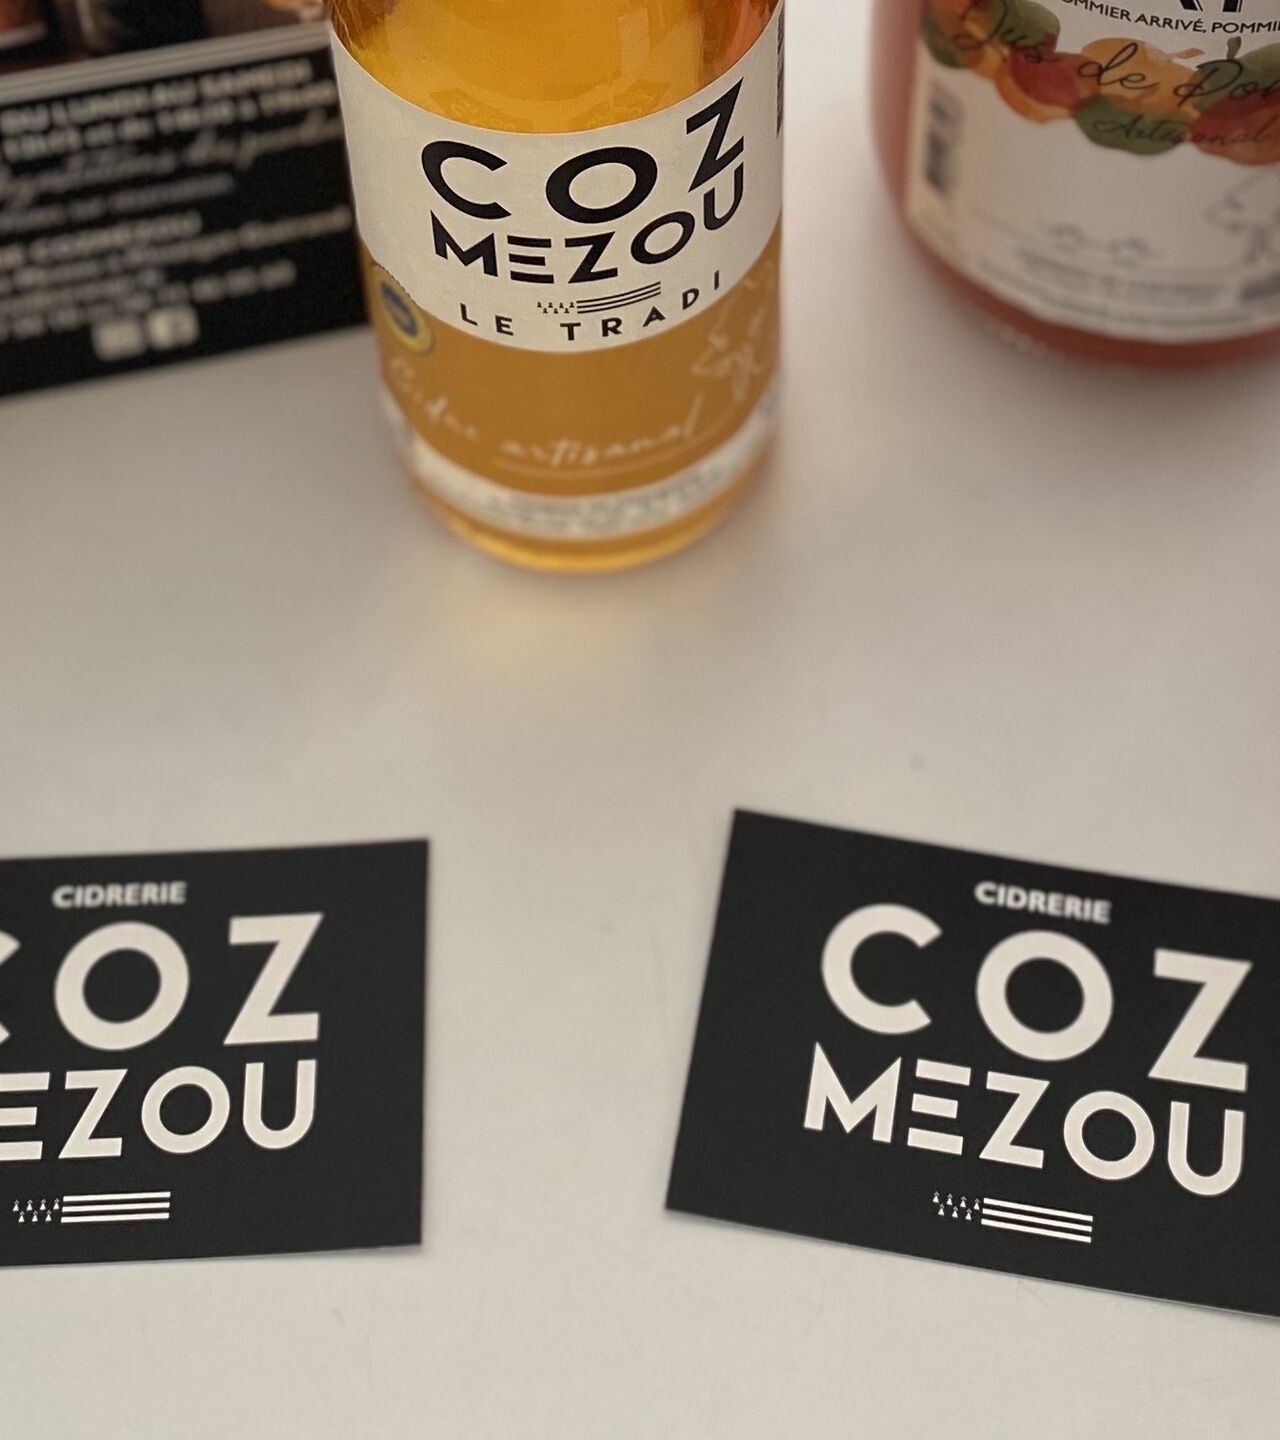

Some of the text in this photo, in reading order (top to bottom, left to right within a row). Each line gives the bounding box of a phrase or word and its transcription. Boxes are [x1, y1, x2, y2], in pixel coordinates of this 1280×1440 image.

[1134, 12, 1207, 36] ARRIVÉ,
[1077, 42, 1157, 91] de
[420, 77, 744, 224] COZ
[1092, 113, 1277, 148] Artisanal
[430, 161, 744, 285] MEZOU
[460, 269, 721, 341] LE TRADI
[51, 881, 188, 909] CIDRERIE
[974, 881, 1113, 925] CIDRERIE
[821, 903, 1253, 1092] COZ
[803, 1041, 1245, 1196] MEZOU
